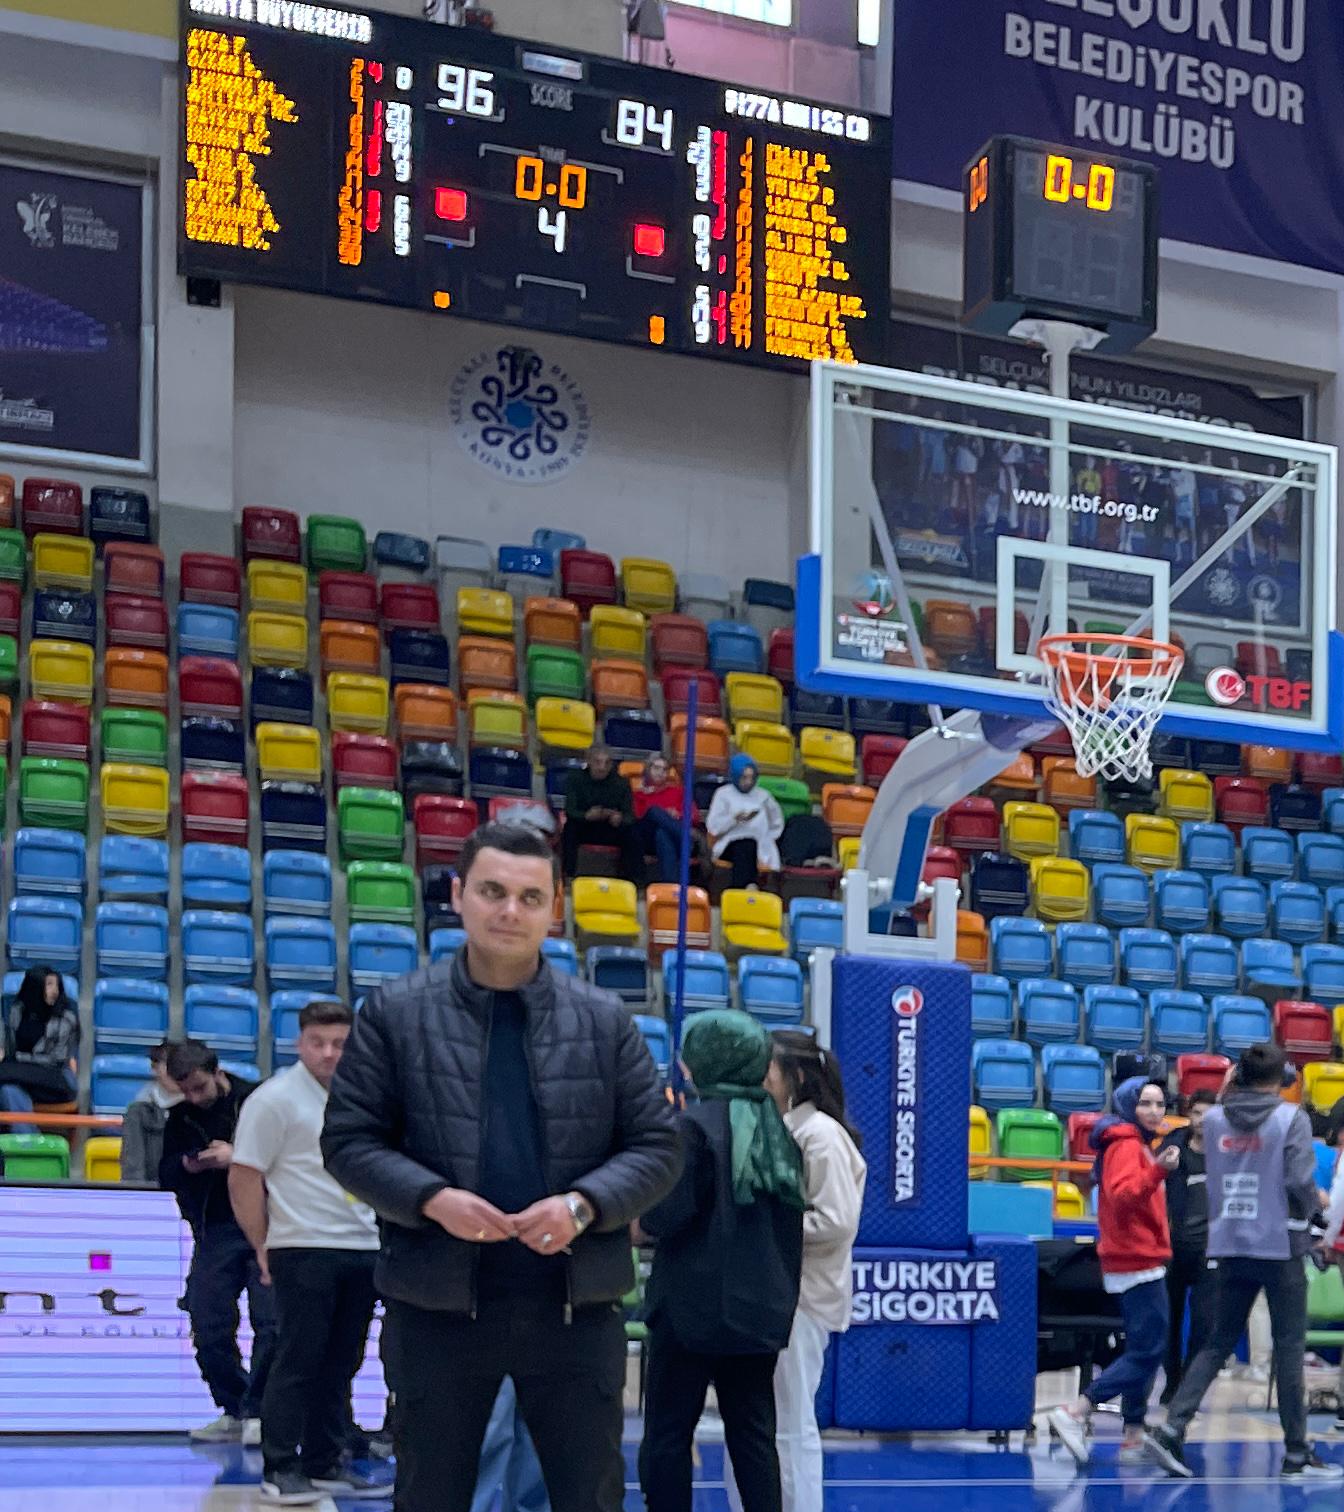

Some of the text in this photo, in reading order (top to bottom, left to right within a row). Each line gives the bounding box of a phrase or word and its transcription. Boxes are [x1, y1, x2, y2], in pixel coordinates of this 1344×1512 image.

[437, 63, 495, 117] 96
[1005, 12, 1306, 124] BELEDİYESPOR
[529, 81, 574, 112] SCORE
[616, 98, 673, 152] 84
[1074, 95, 1236, 169] KULÜBÜ
[537, 206, 567, 254] 4
[1011, 486, 1160, 524] www.tbf.org.tr
[1246, 674, 1312, 711] TBF
